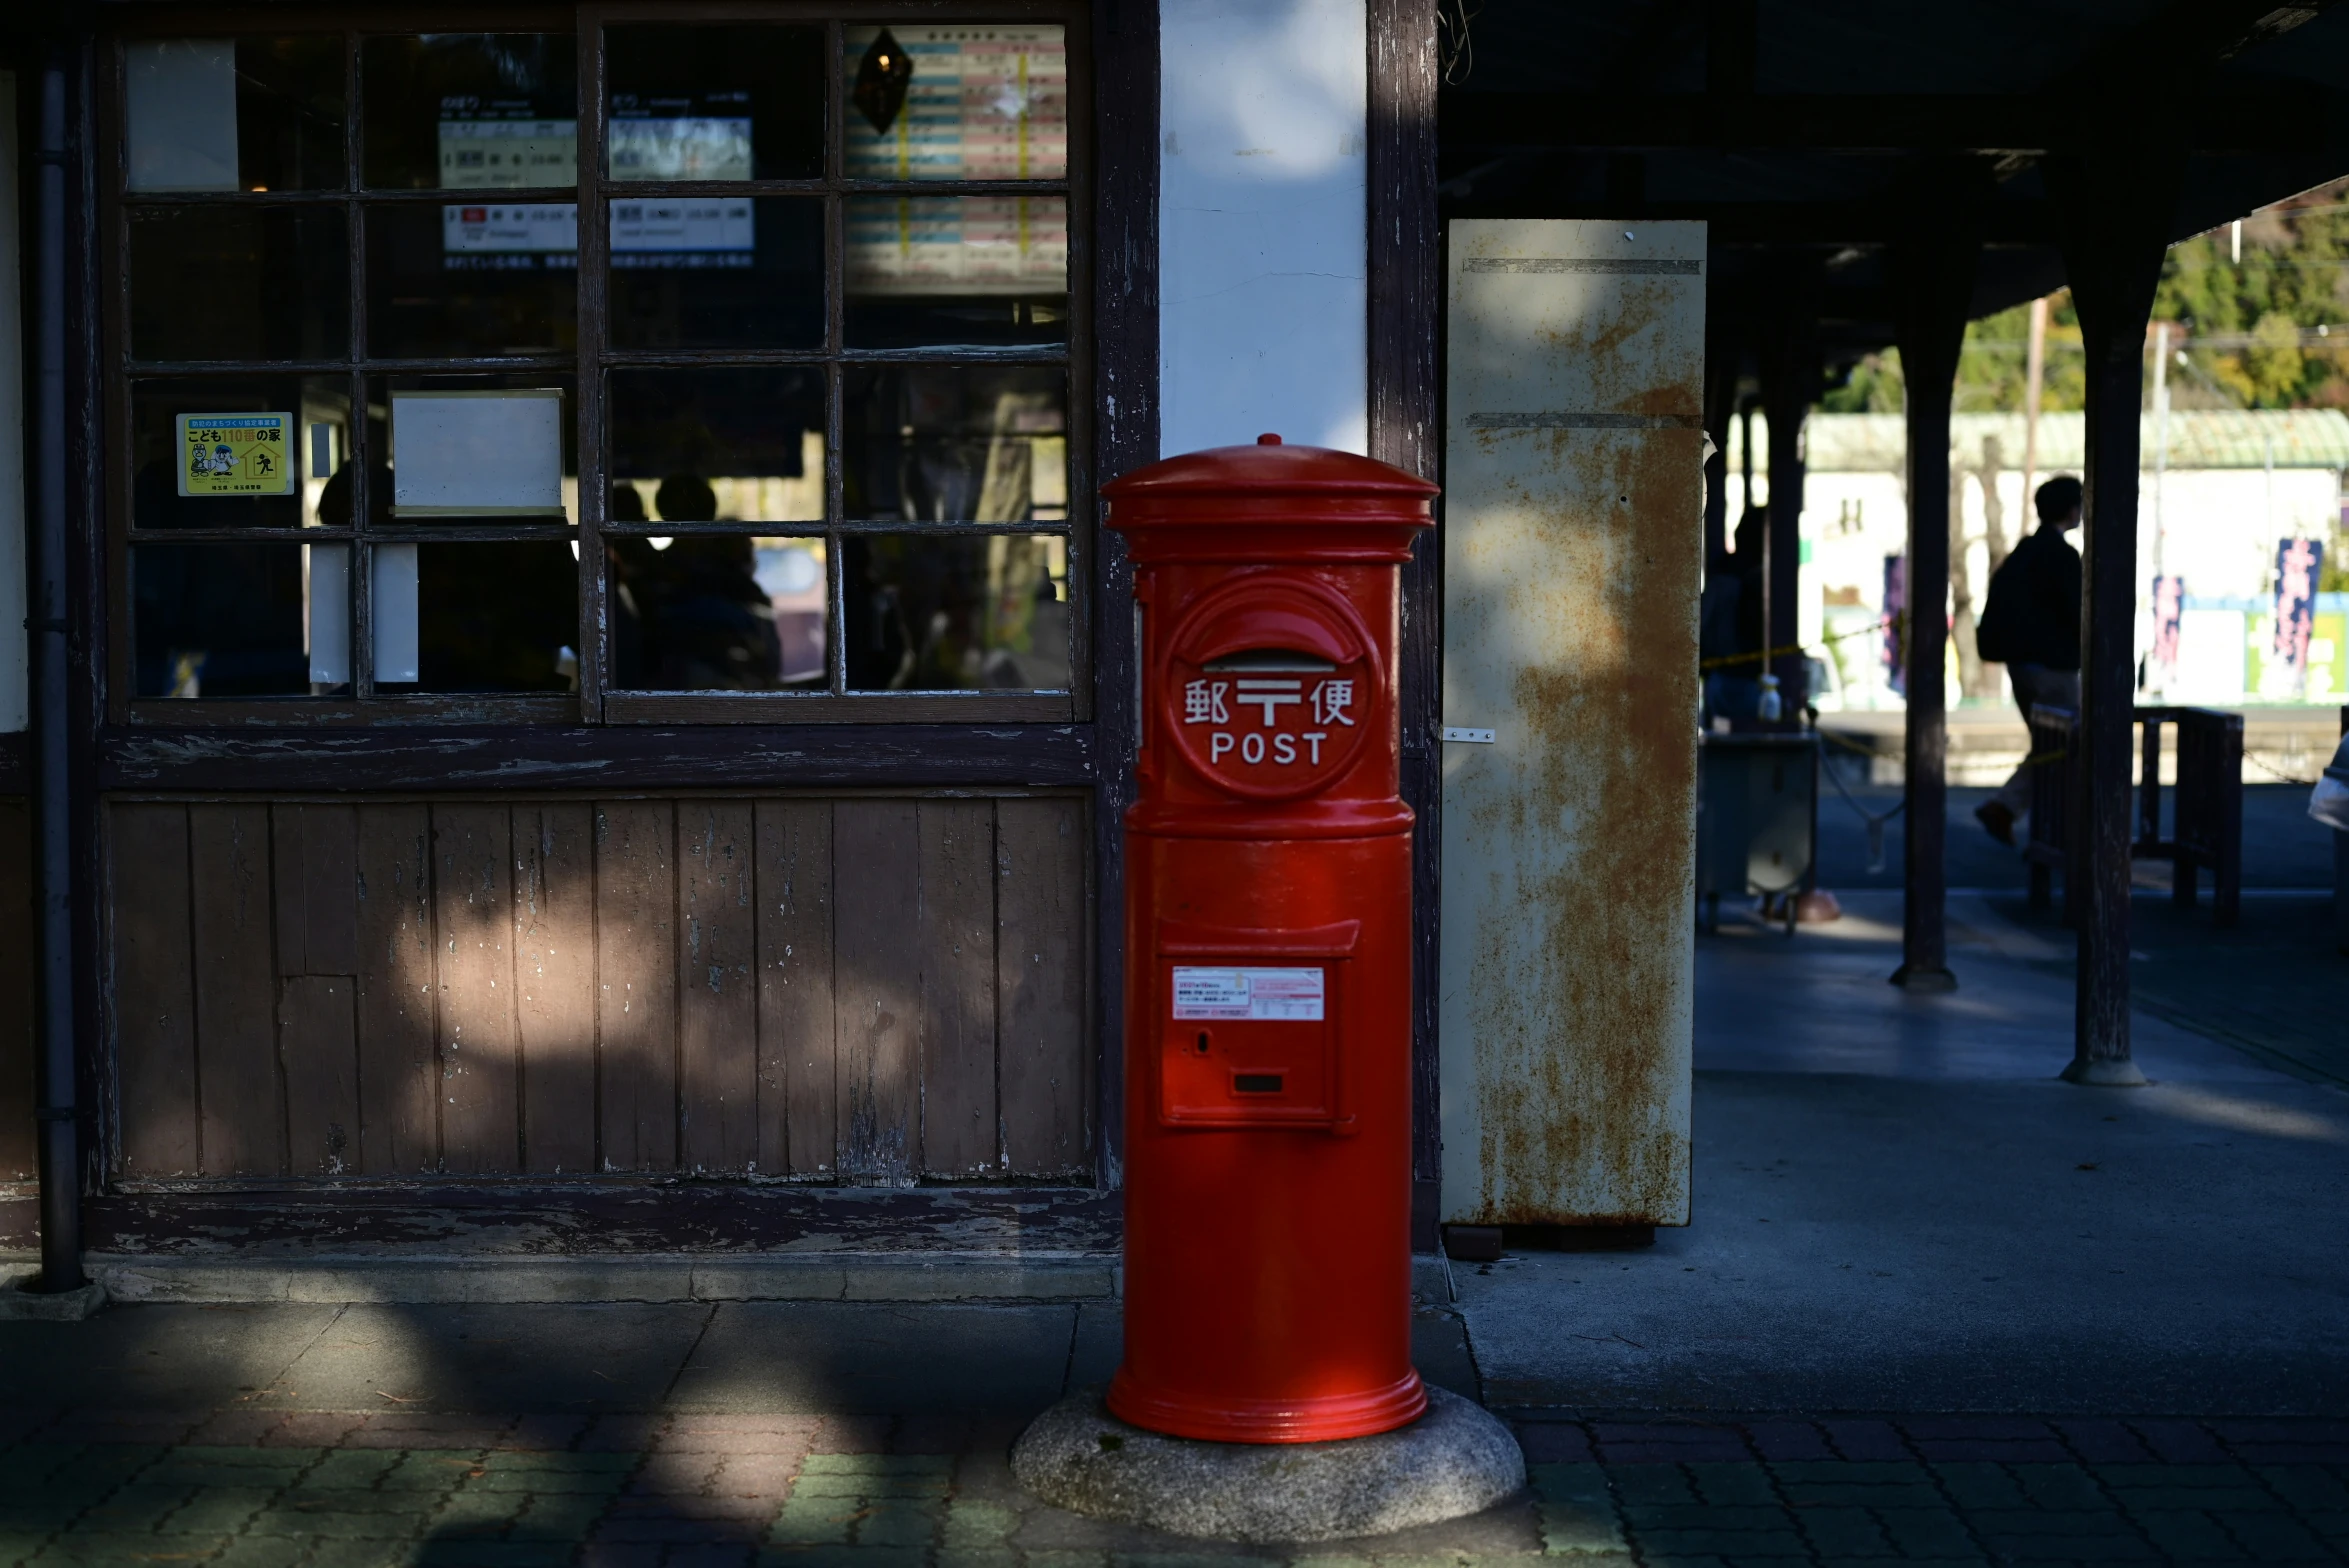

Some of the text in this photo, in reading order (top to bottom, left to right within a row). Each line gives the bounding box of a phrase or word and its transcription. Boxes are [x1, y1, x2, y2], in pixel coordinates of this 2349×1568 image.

[191, 419, 277, 428] 防犯のまちづくり協定事業者
[188, 429, 281, 442] こども110番の家
[1211, 732, 1328, 765] POST
